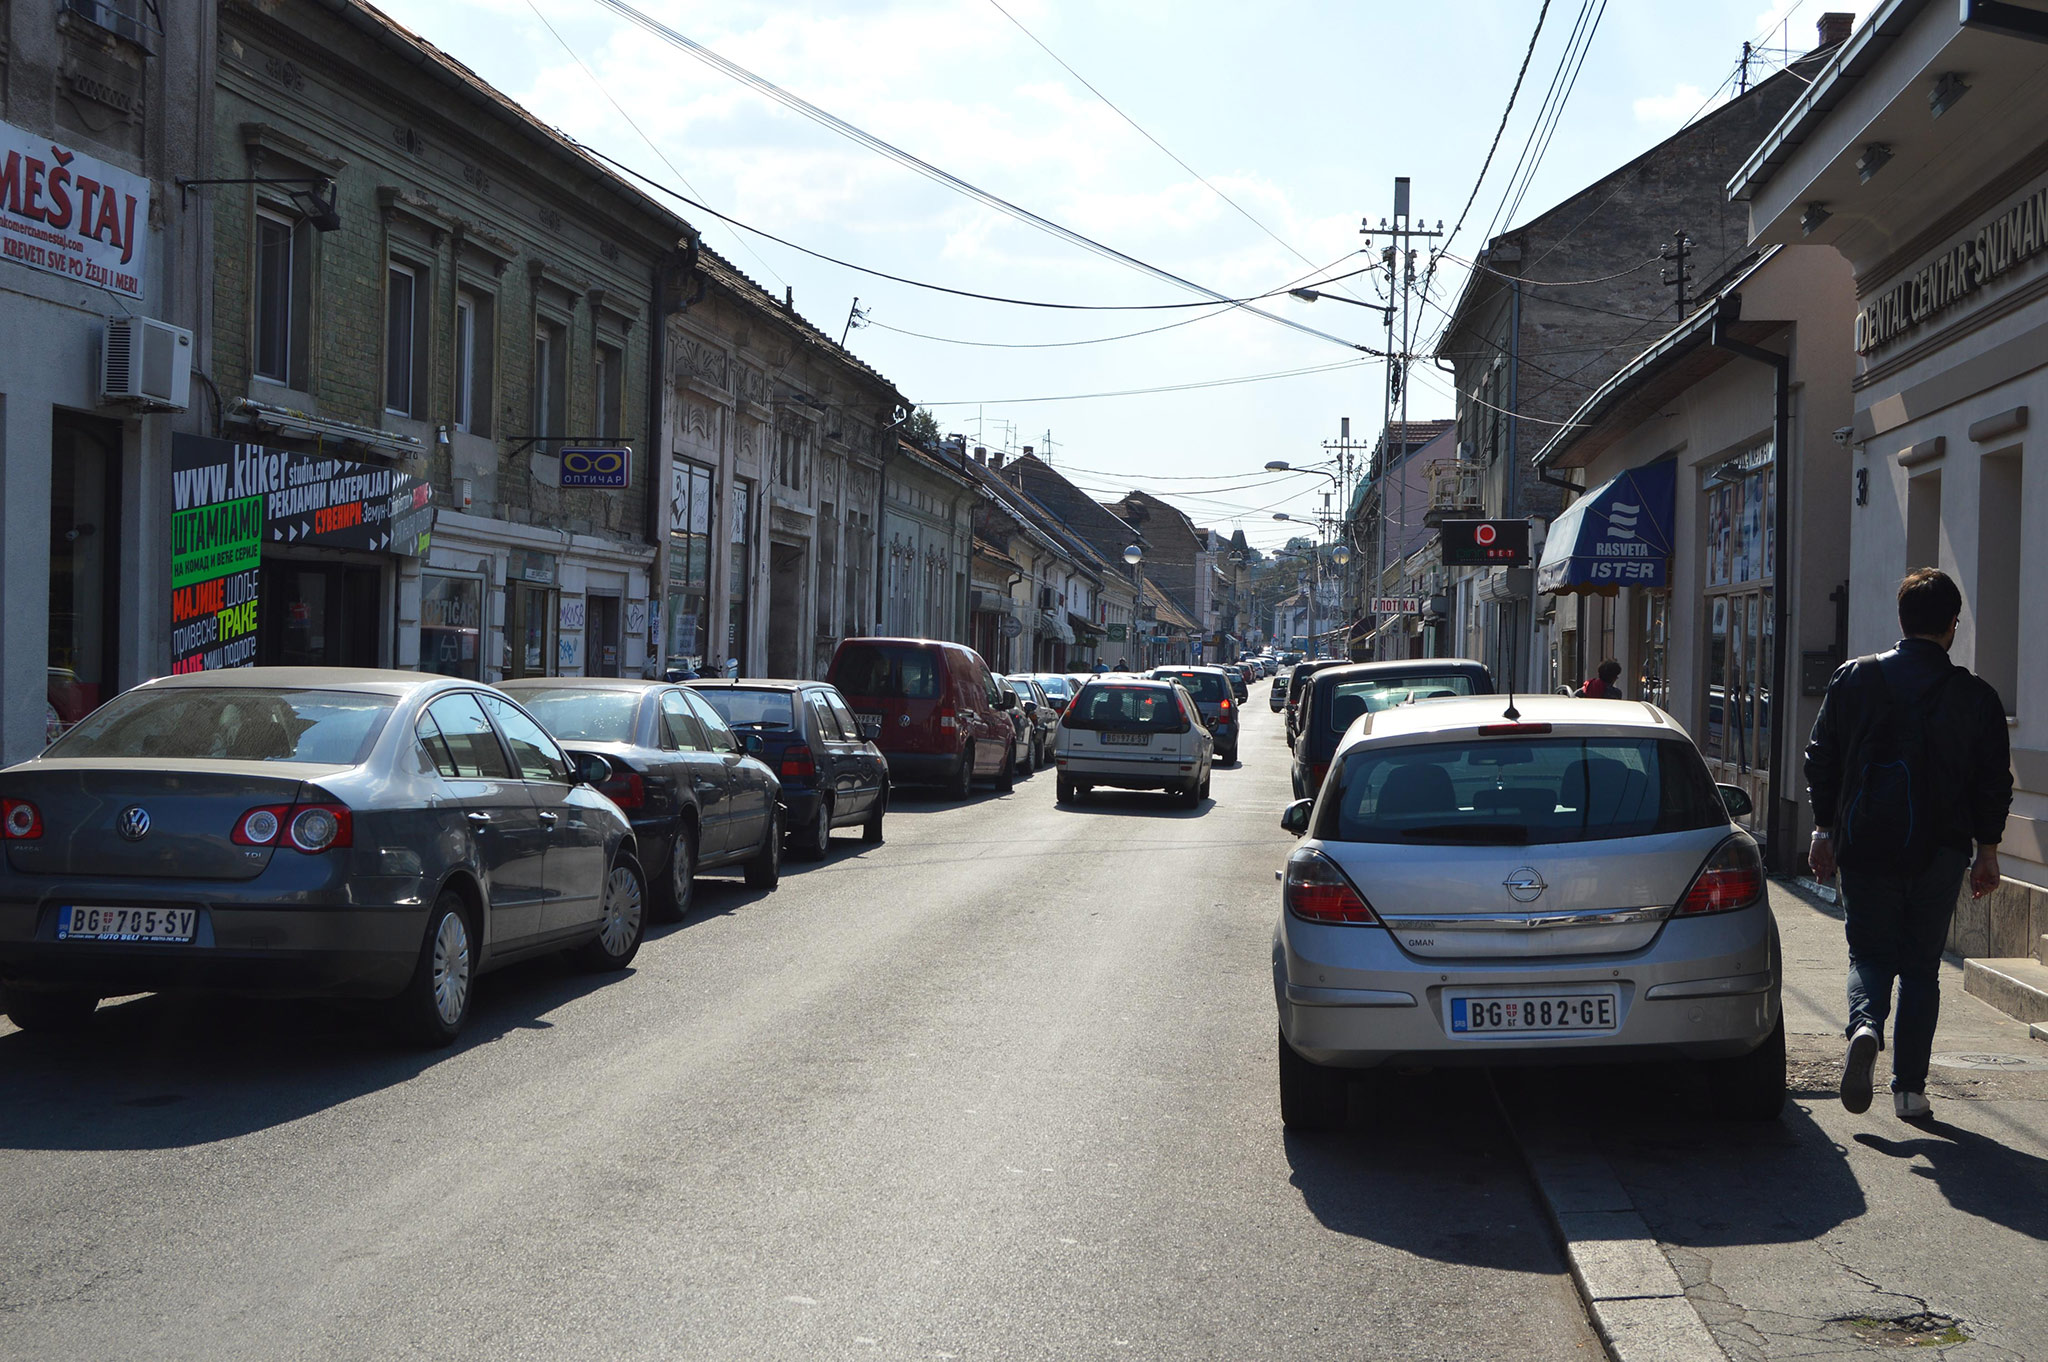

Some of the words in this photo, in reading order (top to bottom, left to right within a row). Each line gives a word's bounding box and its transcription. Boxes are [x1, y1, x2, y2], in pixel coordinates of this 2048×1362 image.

[3, 237, 46, 266] KREVETI
[48, 250, 67, 273] SVE
[69, 257, 84, 277] PO
[115, 271, 138, 294] MERI
[1855, 284, 1909, 353] DENTAL
[564, 475, 622, 483] ОПТИЧАР
[268, 481, 328, 520] РЕКЛАМНИ
[329, 470, 391, 506] МАТЕРИЈАЛ
[173, 500, 261, 556] ШТАМПАМО
[174, 562, 183, 577] НА
[185, 555, 209, 574] КОМАД
[211, 553, 216, 568] И
[217, 549, 233, 566] ВЕЋЕ
[235, 544, 258, 562] СЕРИЈЕ
[1596, 543, 1649, 556] RASVETA
[1591, 562, 1655, 578] ISTER
[173, 578, 225, 623] МАЈИЦЕ
[227, 569, 259, 607] ШОЉЕ
[173, 616, 217, 660] привеске
[217, 600, 258, 641] ТРАКЕ
[73, 909, 99, 932] BG
[97, 933, 119, 941] AUTO
[1409, 939, 1434, 947] GMAN
[1471, 1002, 1502, 1027] BG
